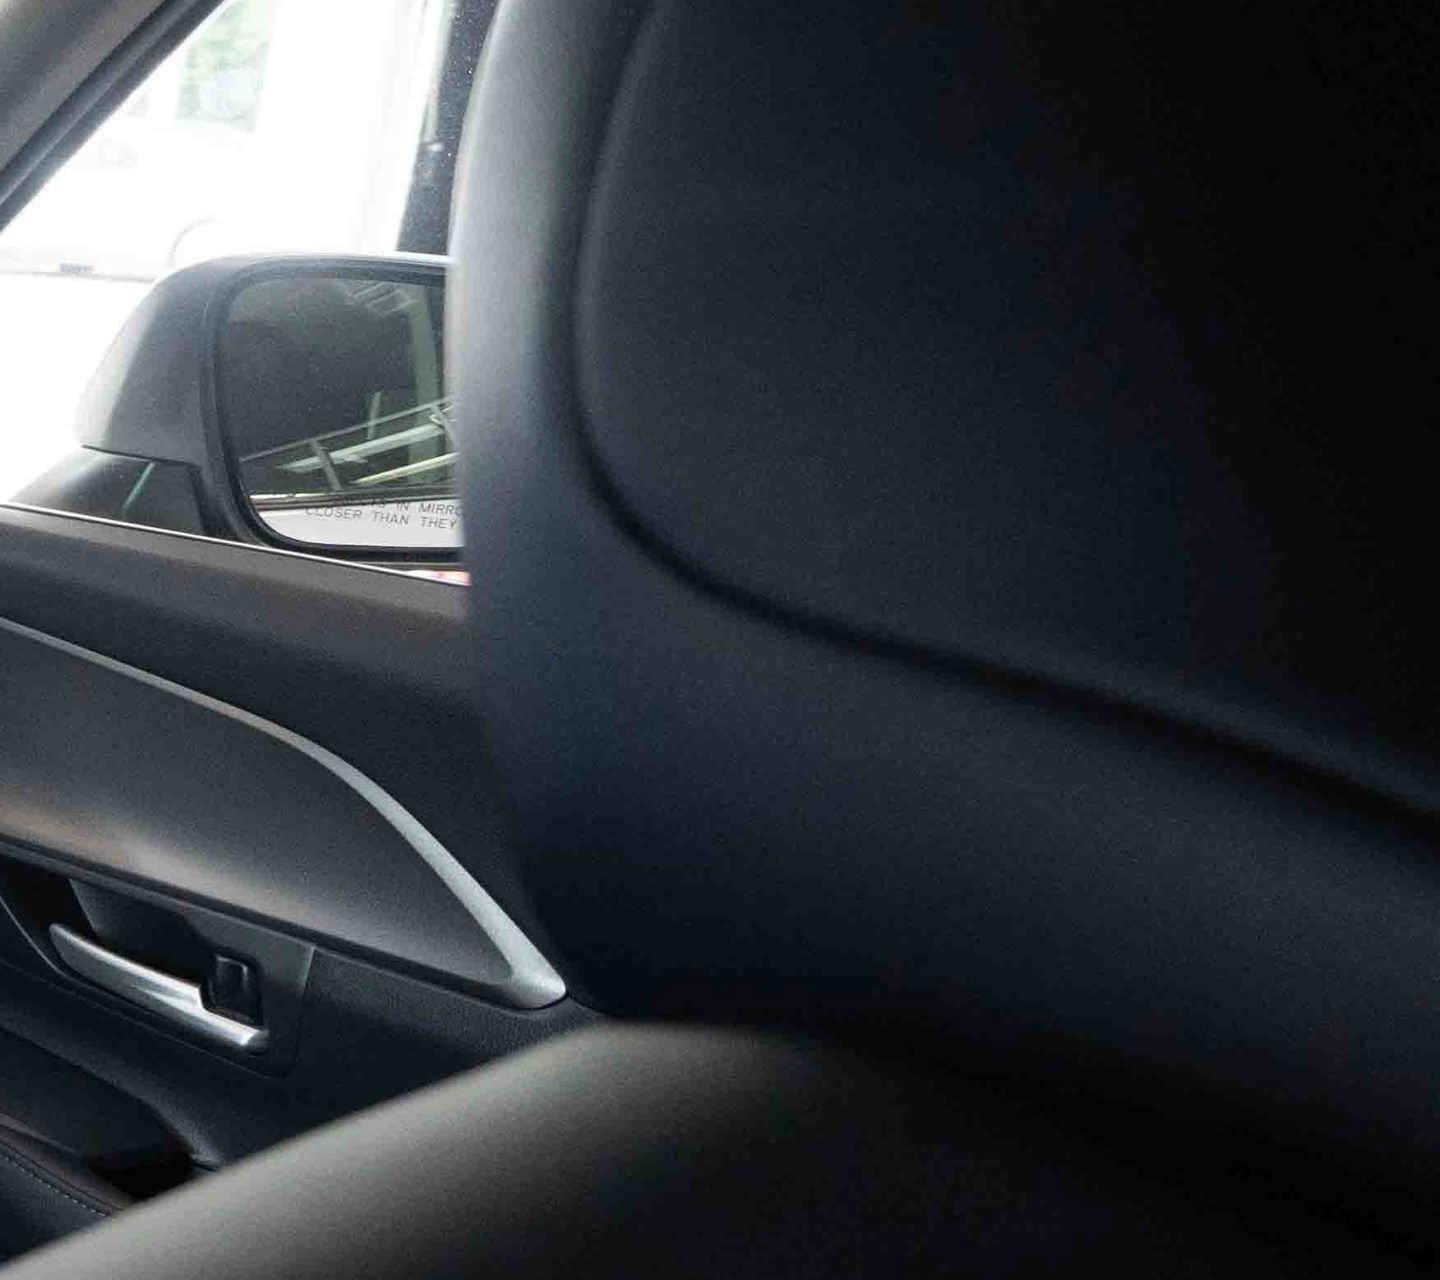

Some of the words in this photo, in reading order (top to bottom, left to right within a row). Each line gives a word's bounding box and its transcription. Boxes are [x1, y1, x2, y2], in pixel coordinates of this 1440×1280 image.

[305, 507, 362, 520] CLOSER
[373, 511, 409, 526] THAN
[420, 516, 458, 529] THEY
